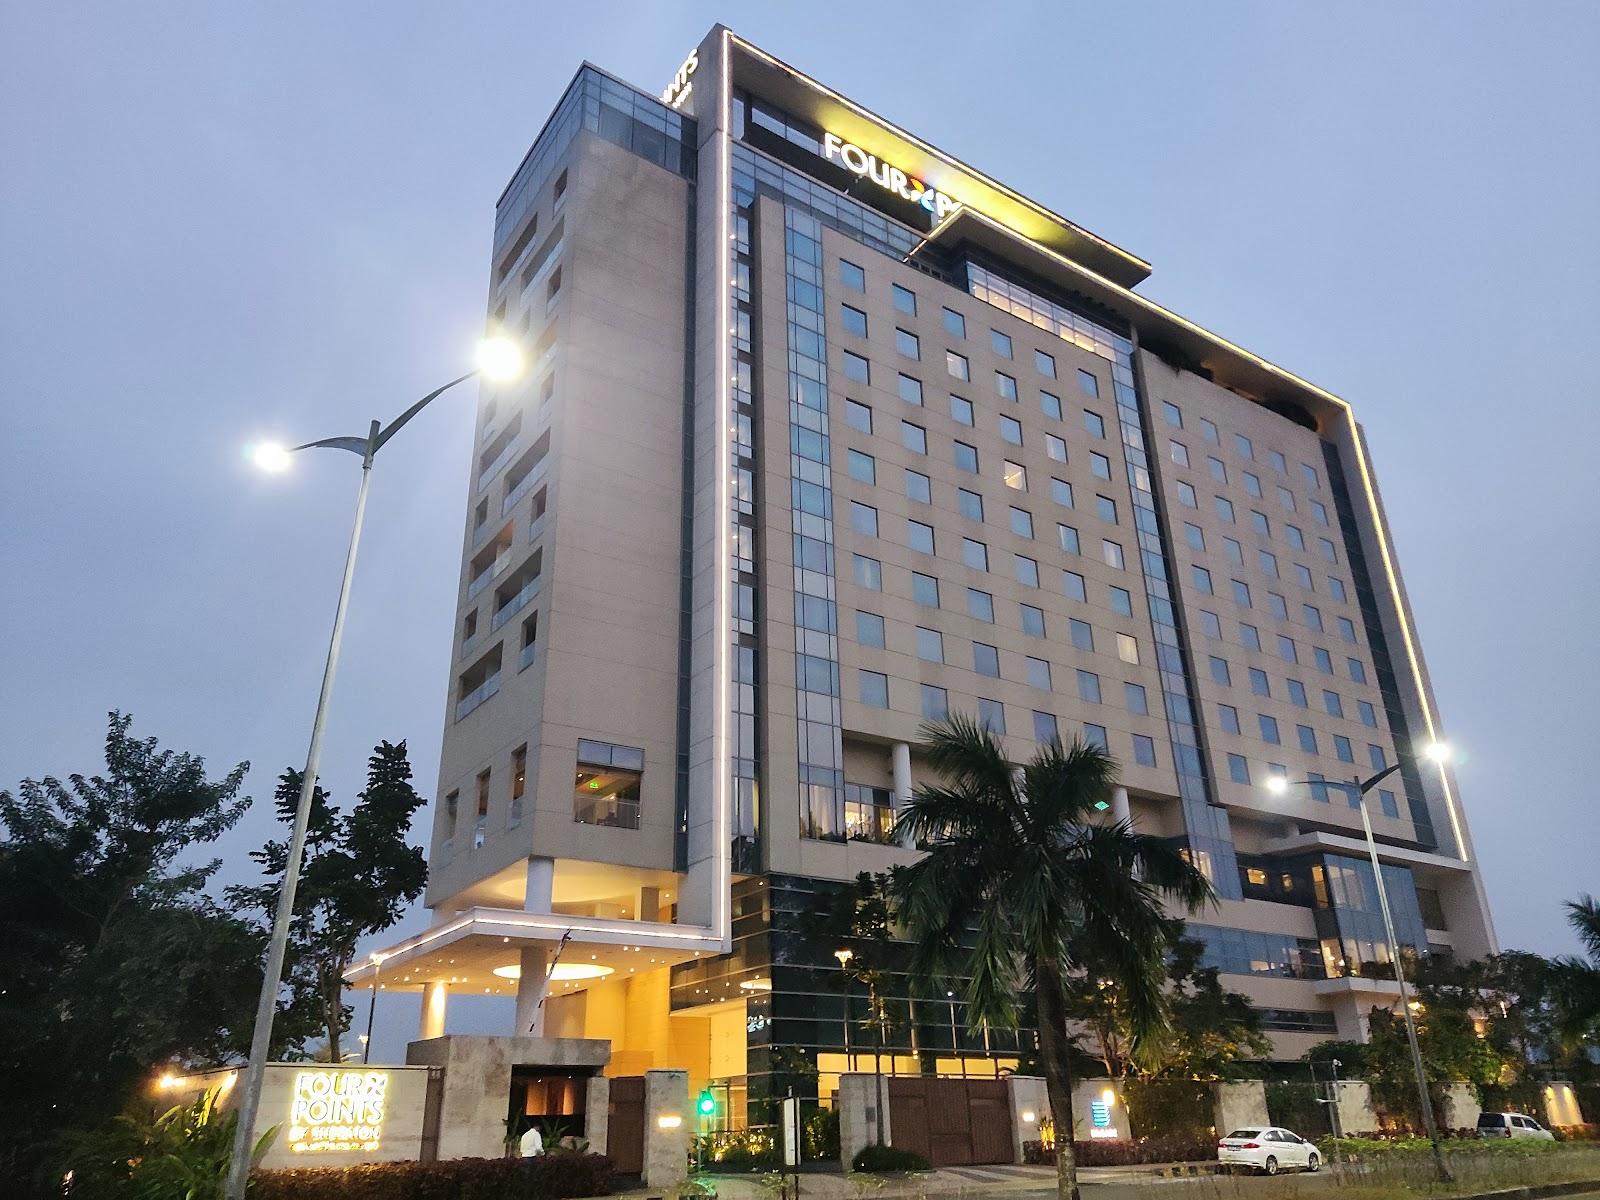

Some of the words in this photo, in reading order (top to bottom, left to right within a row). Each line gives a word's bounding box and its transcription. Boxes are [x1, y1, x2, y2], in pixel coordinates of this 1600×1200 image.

[824, 132, 911, 199] FOUR
[935, 191, 963, 218] P
[297, 1072, 363, 1097] FOUR
[292, 1098, 384, 1124] POINTS
